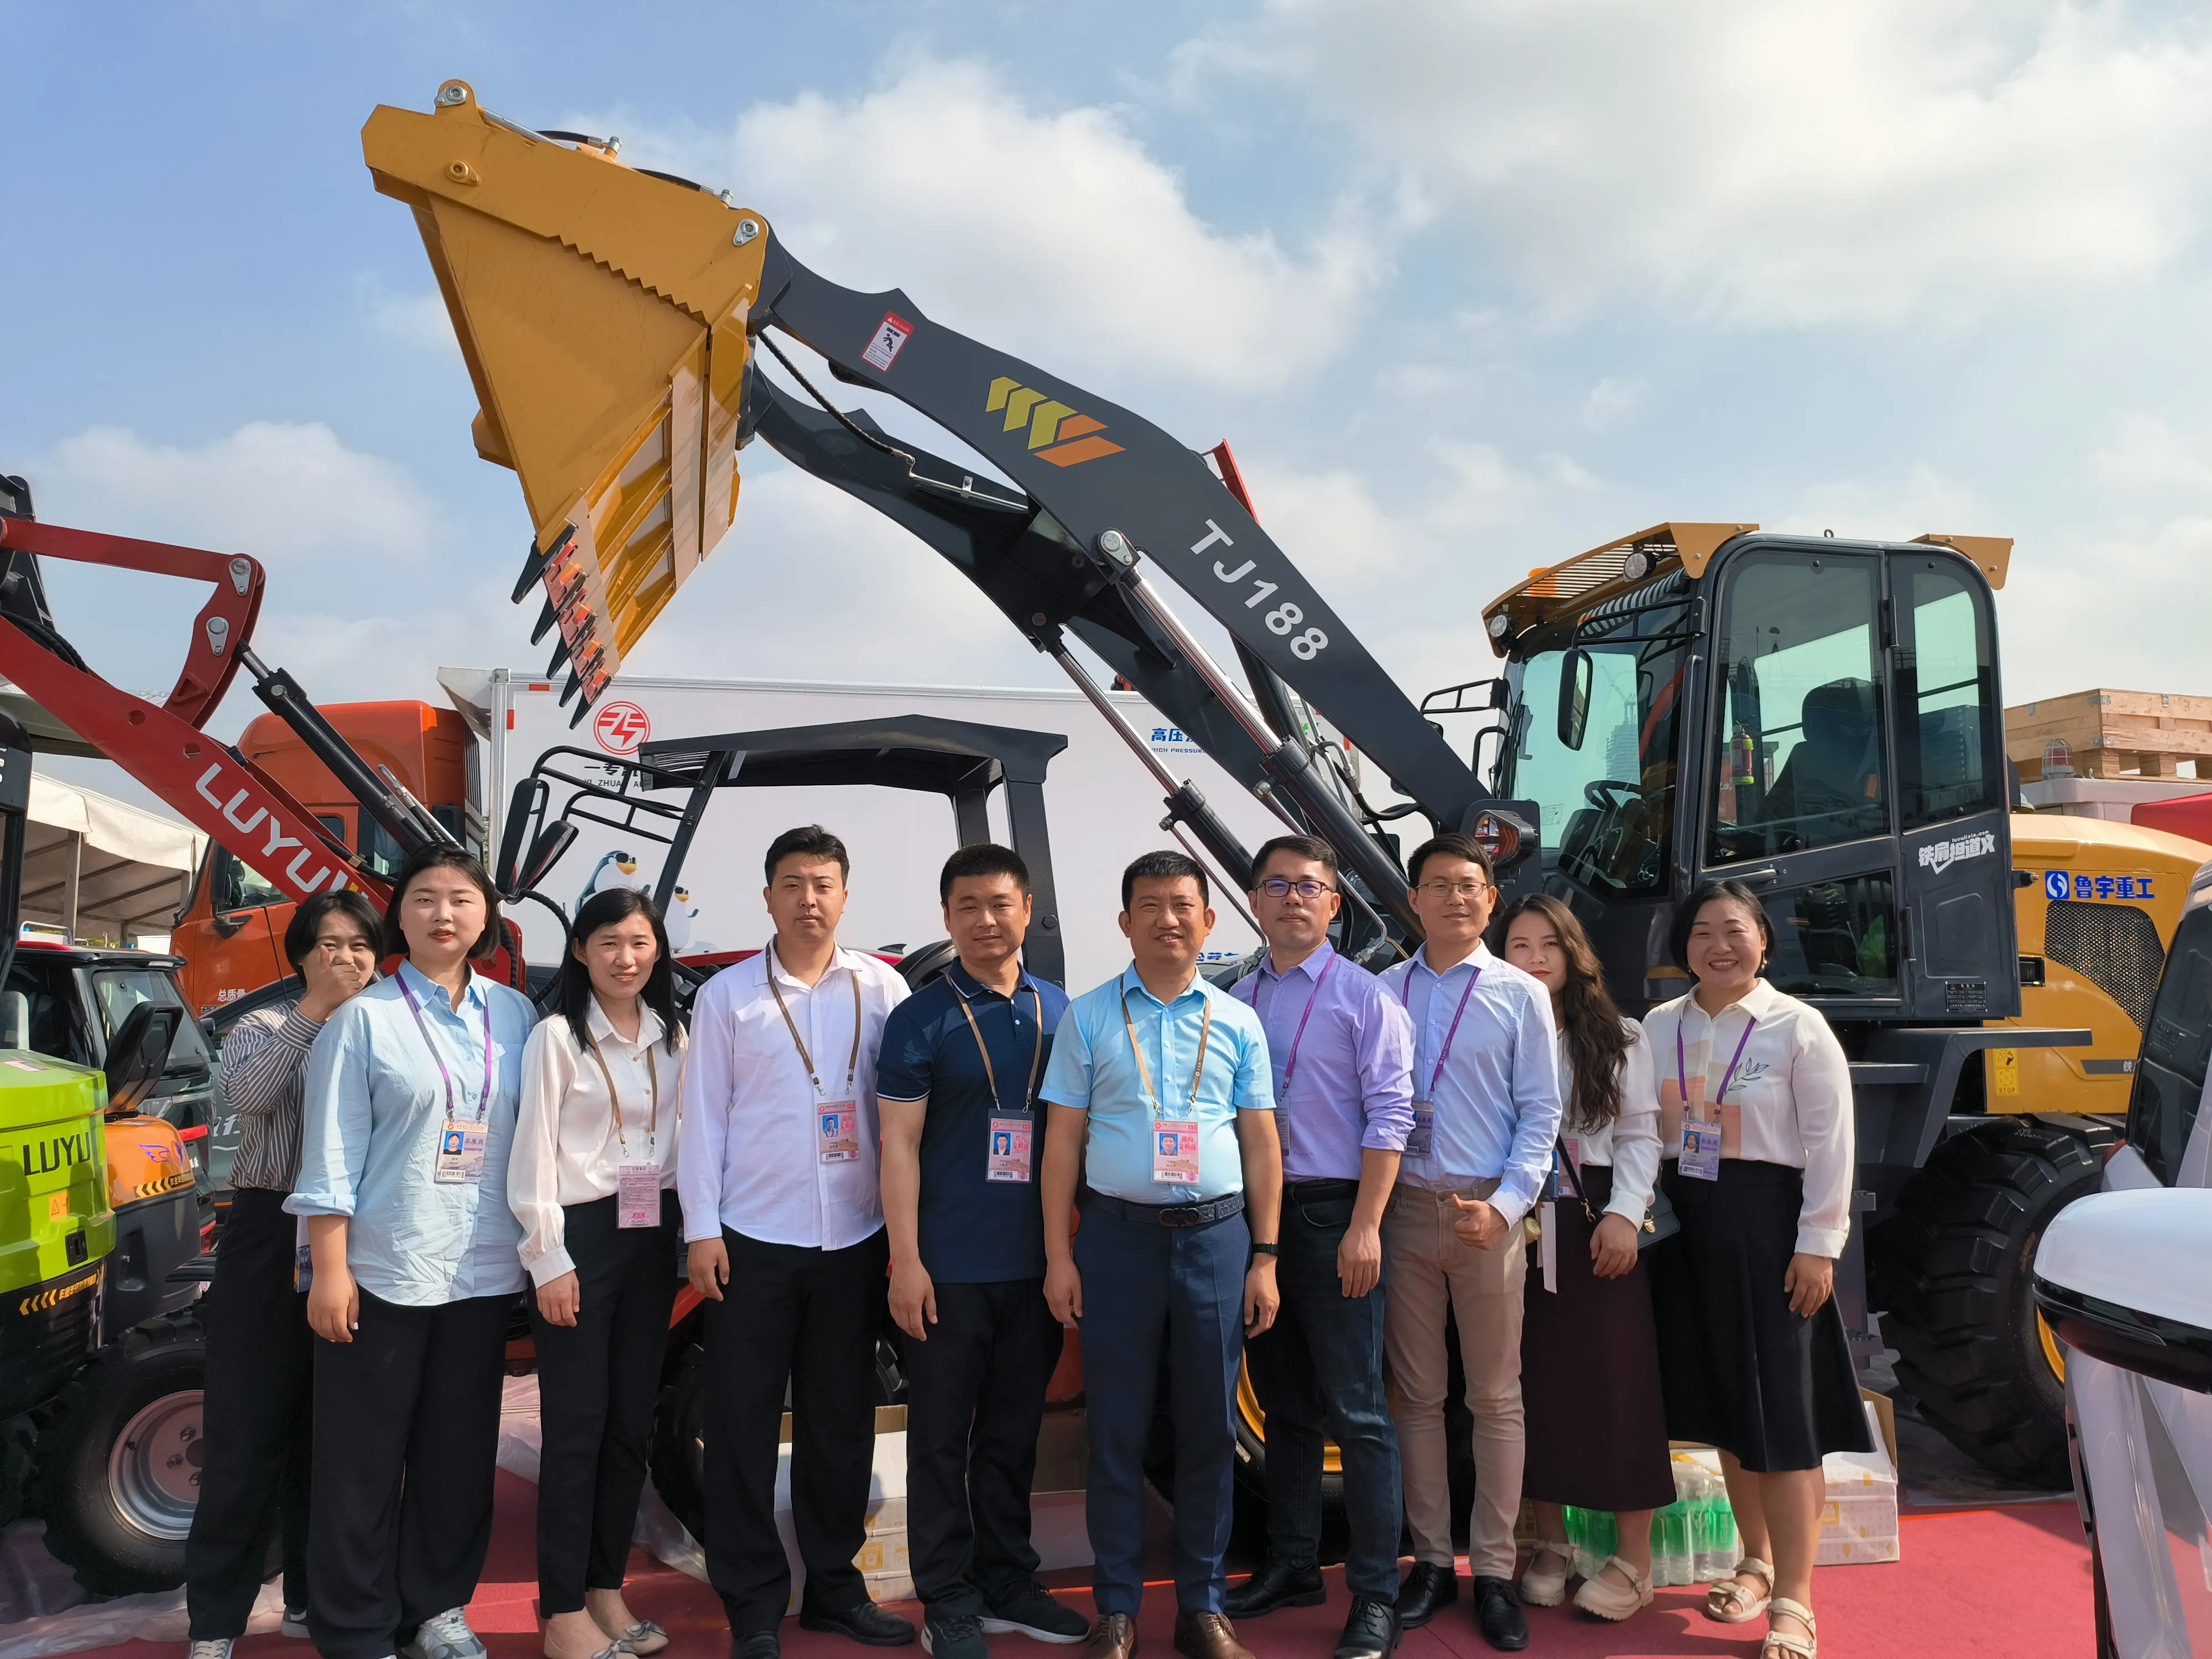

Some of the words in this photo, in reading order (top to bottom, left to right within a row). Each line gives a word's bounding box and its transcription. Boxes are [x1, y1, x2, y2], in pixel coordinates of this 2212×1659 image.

[1190, 519, 1328, 660] TJ188
[1918, 834, 1995, 874] 铁肩担道义
[2074, 875, 2155, 899] 鲁宇重工
[23, 1132, 91, 1176] LUYU
